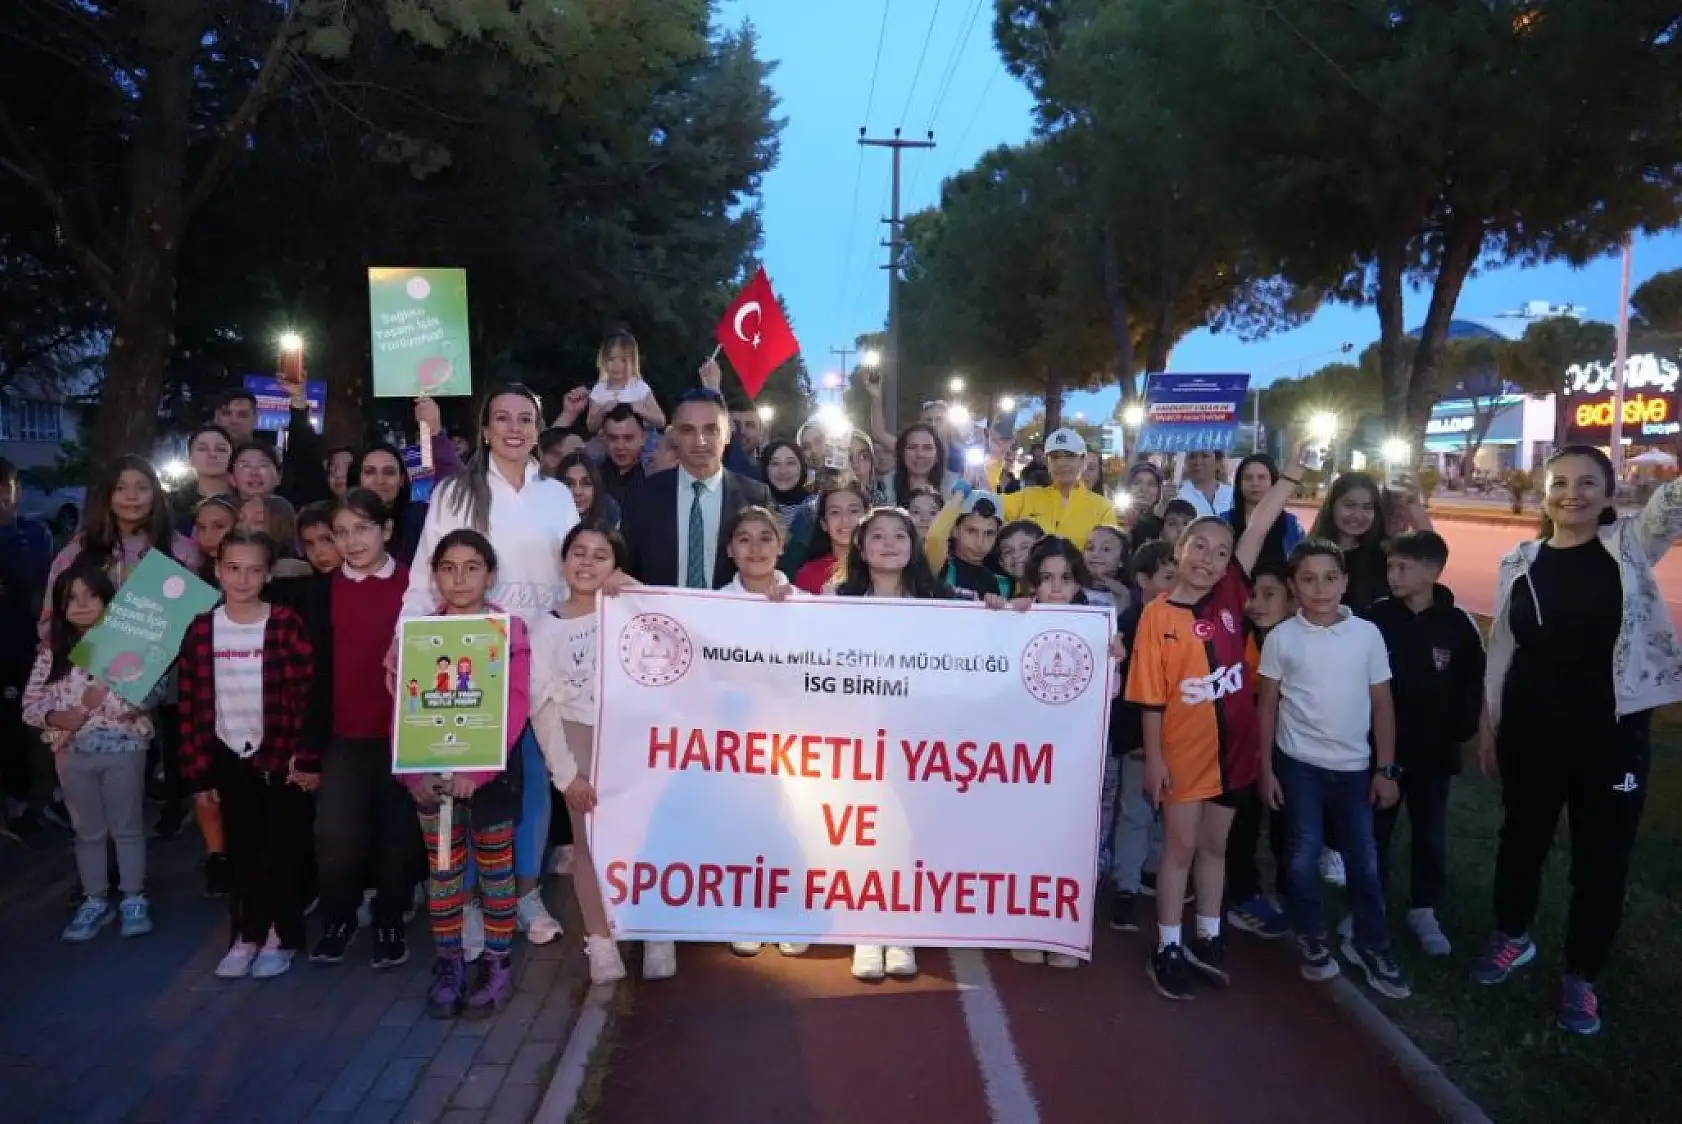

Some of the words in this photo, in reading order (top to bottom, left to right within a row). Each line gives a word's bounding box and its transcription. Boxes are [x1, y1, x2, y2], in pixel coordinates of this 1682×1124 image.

[836, 649, 895, 668] EĞİTİM
[900, 652, 1010, 673] MÜDÜRLÜĞÜ
[804, 672, 836, 694] İSG
[842, 675, 909, 697] BİRİMİ
[647, 726, 887, 781] HAREKETLİ
[900, 740, 1054, 793] YAŞAM
[821, 802, 878, 846] VE
[606, 855, 791, 909] SPORTİF
[805, 860, 1080, 922] FAALİYETLER
